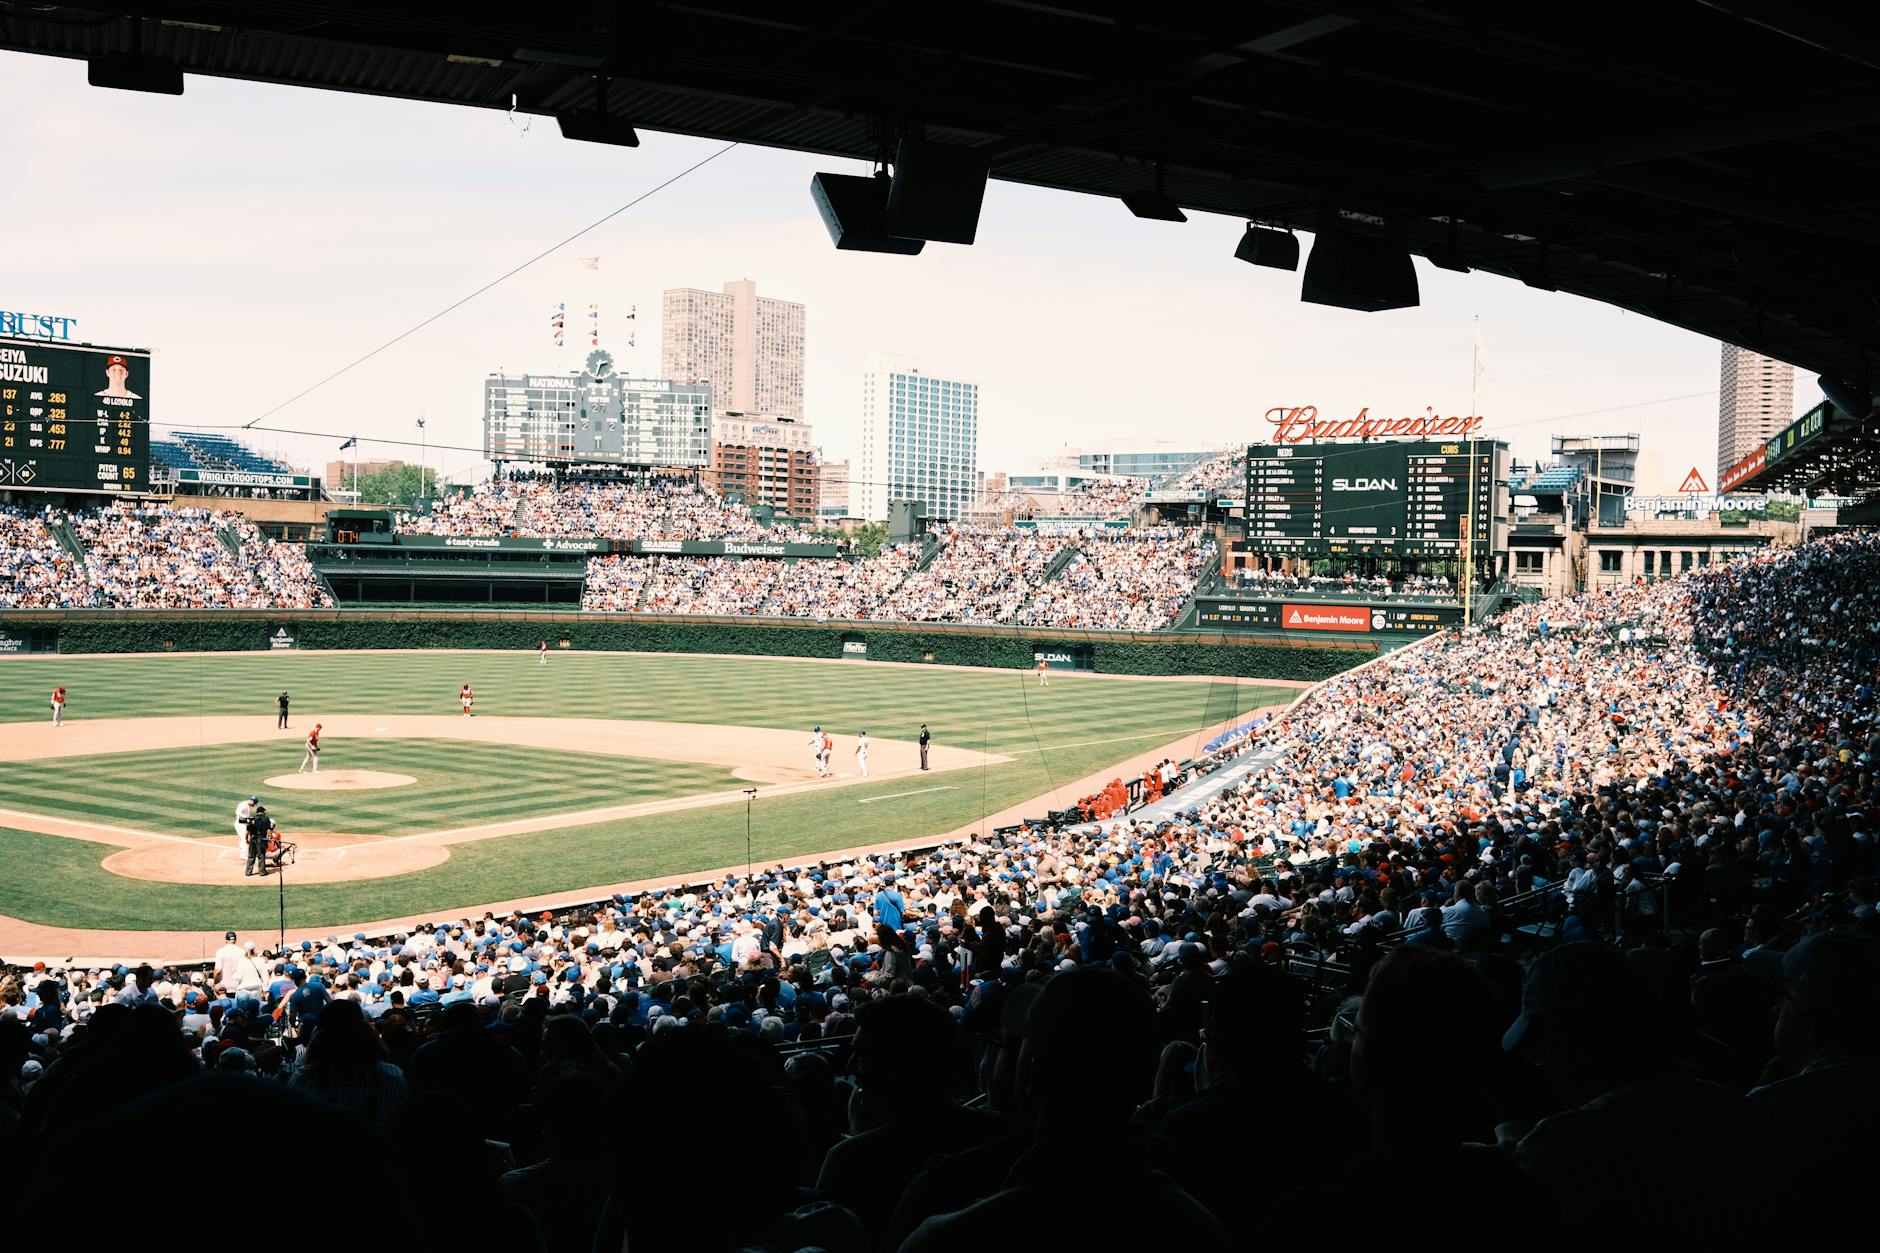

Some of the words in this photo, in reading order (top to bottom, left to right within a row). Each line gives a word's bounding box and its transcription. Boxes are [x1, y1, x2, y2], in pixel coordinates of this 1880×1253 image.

[529, 378, 575, 388] NATIONAL
[623, 381, 670, 391] AMERICAN
[3, 389, 17, 400] 137
[30, 392, 43, 400] AVG
[48, 392, 66, 404] .263
[6, 405, 13, 415] 6
[48, 408, 66, 419] .325
[30, 423, 42, 432] SLG
[48, 424, 66, 434] .453
[1265, 406, 1484, 444] Budweiser
[5, 436, 14, 447] 21
[48, 440, 66, 450] .777
[1441, 445, 1459, 454] CUBS
[97, 472, 118, 480] COUNT
[98, 464, 118, 473] PITCH
[122, 467, 136, 479] 65
[198, 471, 294, 486] WRIGLEYROOFTOPS.COM
[1624, 496, 1704, 513] Benjamin
[1708, 496, 1766, 511] Moore
[1330, 526, 1335, 534] 4
[1391, 527, 1396, 535] 3
[452, 538, 500, 547] tastytrade
[556, 541, 598, 550] Advocate
[724, 543, 785, 555] Budweiser
[1304, 614, 1338, 624] Benjamin
[1338, 616, 1364, 624] Moore
